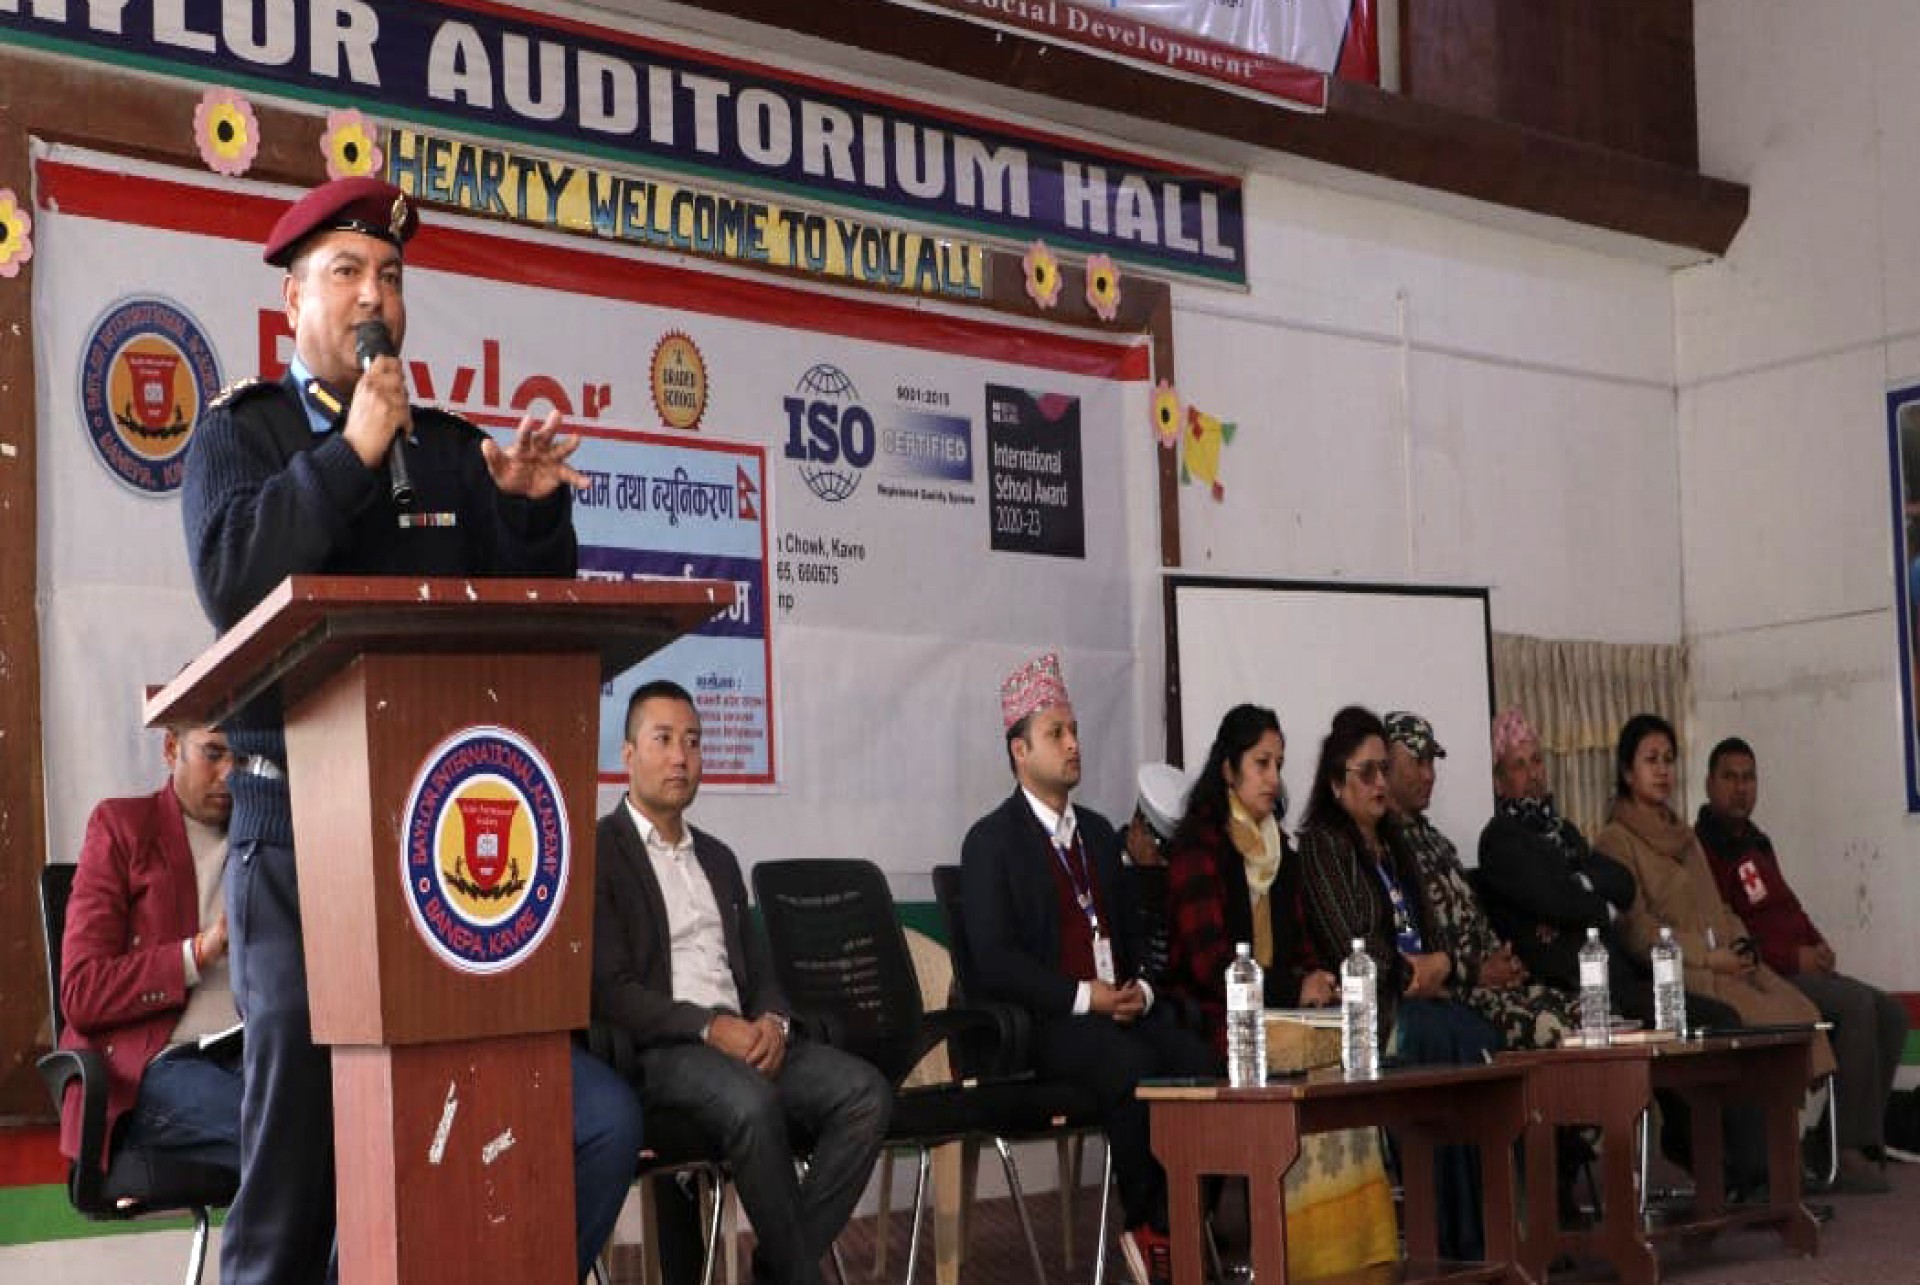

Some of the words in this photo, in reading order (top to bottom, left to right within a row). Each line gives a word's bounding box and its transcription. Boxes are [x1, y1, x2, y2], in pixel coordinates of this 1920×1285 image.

[428, 19, 1029, 218] AUDITORIUM
[1061, 160, 1236, 261] HALL
[390, 130, 575, 225] HEARTY
[588, 170, 769, 261] WELCOME
[780, 210, 826, 271] TO
[835, 219, 906, 287] YOU
[917, 239, 981, 299] ALL
[783, 395, 876, 468] ISO
[884, 430, 968, 462] CERTIFIED
[994, 442, 1062, 474] International
[616, 474, 647, 512] तथा
[652, 467, 734, 526] न्यूनिकरण
[994, 473, 1033, 502] School
[1034, 480, 1068, 507] Award
[412, 788, 438, 866] BAYLOR
[431, 742, 536, 788] INTERNATIONAL
[532, 783, 558, 878] ACADEMY
[490, 906, 538, 953] KAVRE
